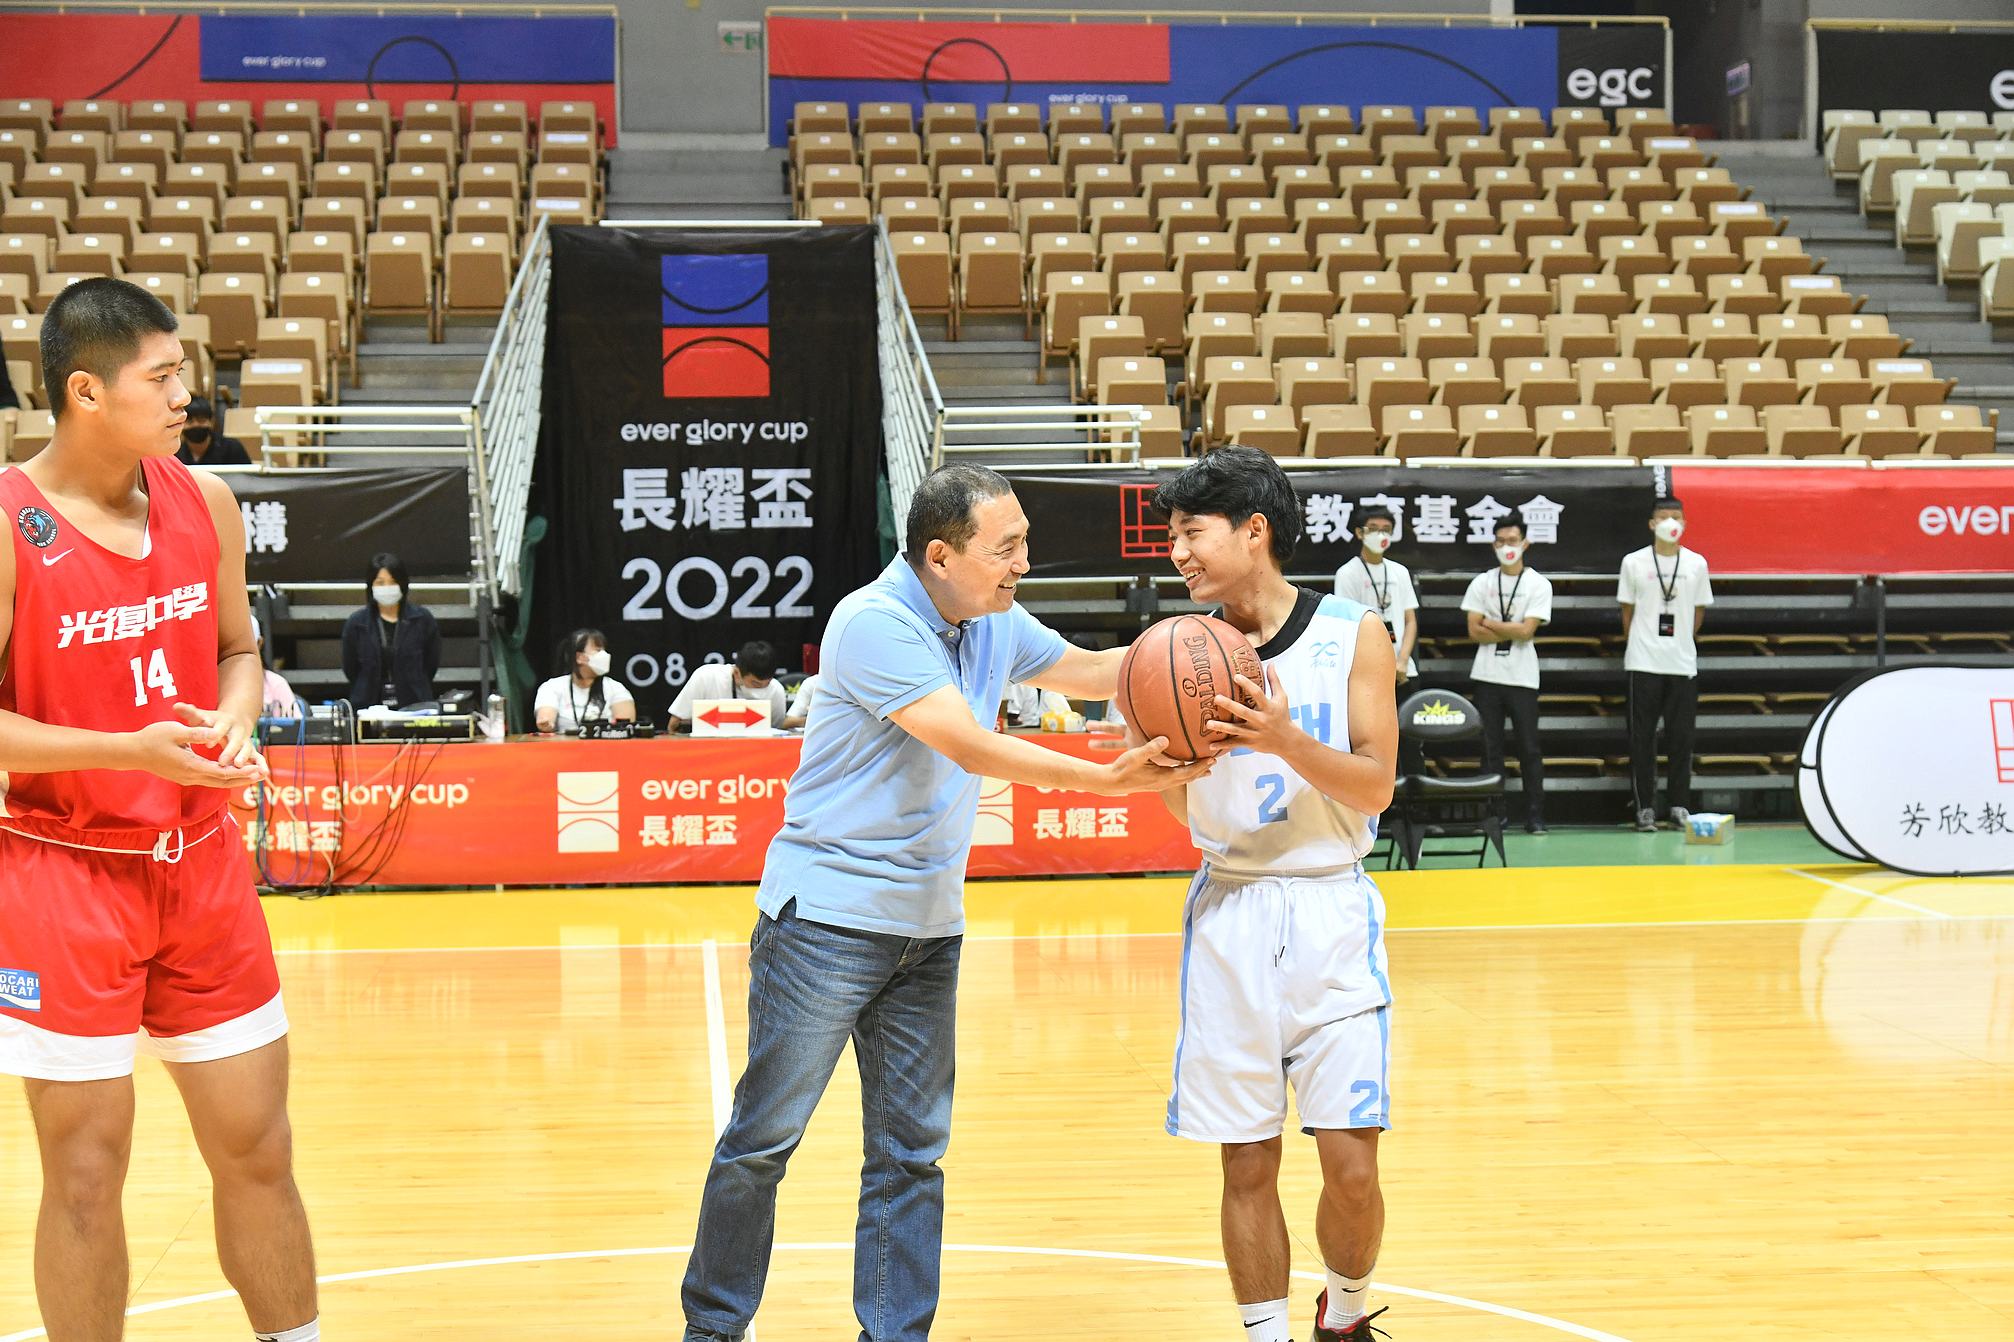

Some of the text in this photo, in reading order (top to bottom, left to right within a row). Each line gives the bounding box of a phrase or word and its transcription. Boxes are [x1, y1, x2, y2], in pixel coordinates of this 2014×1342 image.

[1567, 67, 1653, 106] egc
[620, 419, 809, 446] ever glory cup
[613, 467, 813, 532] 長耀盃
[1918, 505, 2014, 536] ever
[621, 556, 814, 621] 2022
[57, 582, 208, 649] 光復中學
[130, 647, 178, 707] 14
[243, 780, 469, 810] ever glory cup
[641, 779, 712, 801] ever
[1255, 773, 1288, 824] 2
[638, 815, 738, 847] 長耀盃
[1033, 807, 1129, 839] 長耀盃
[1900, 801, 2014, 838] 芳欣教
[1350, 1080, 1377, 1126] 2
